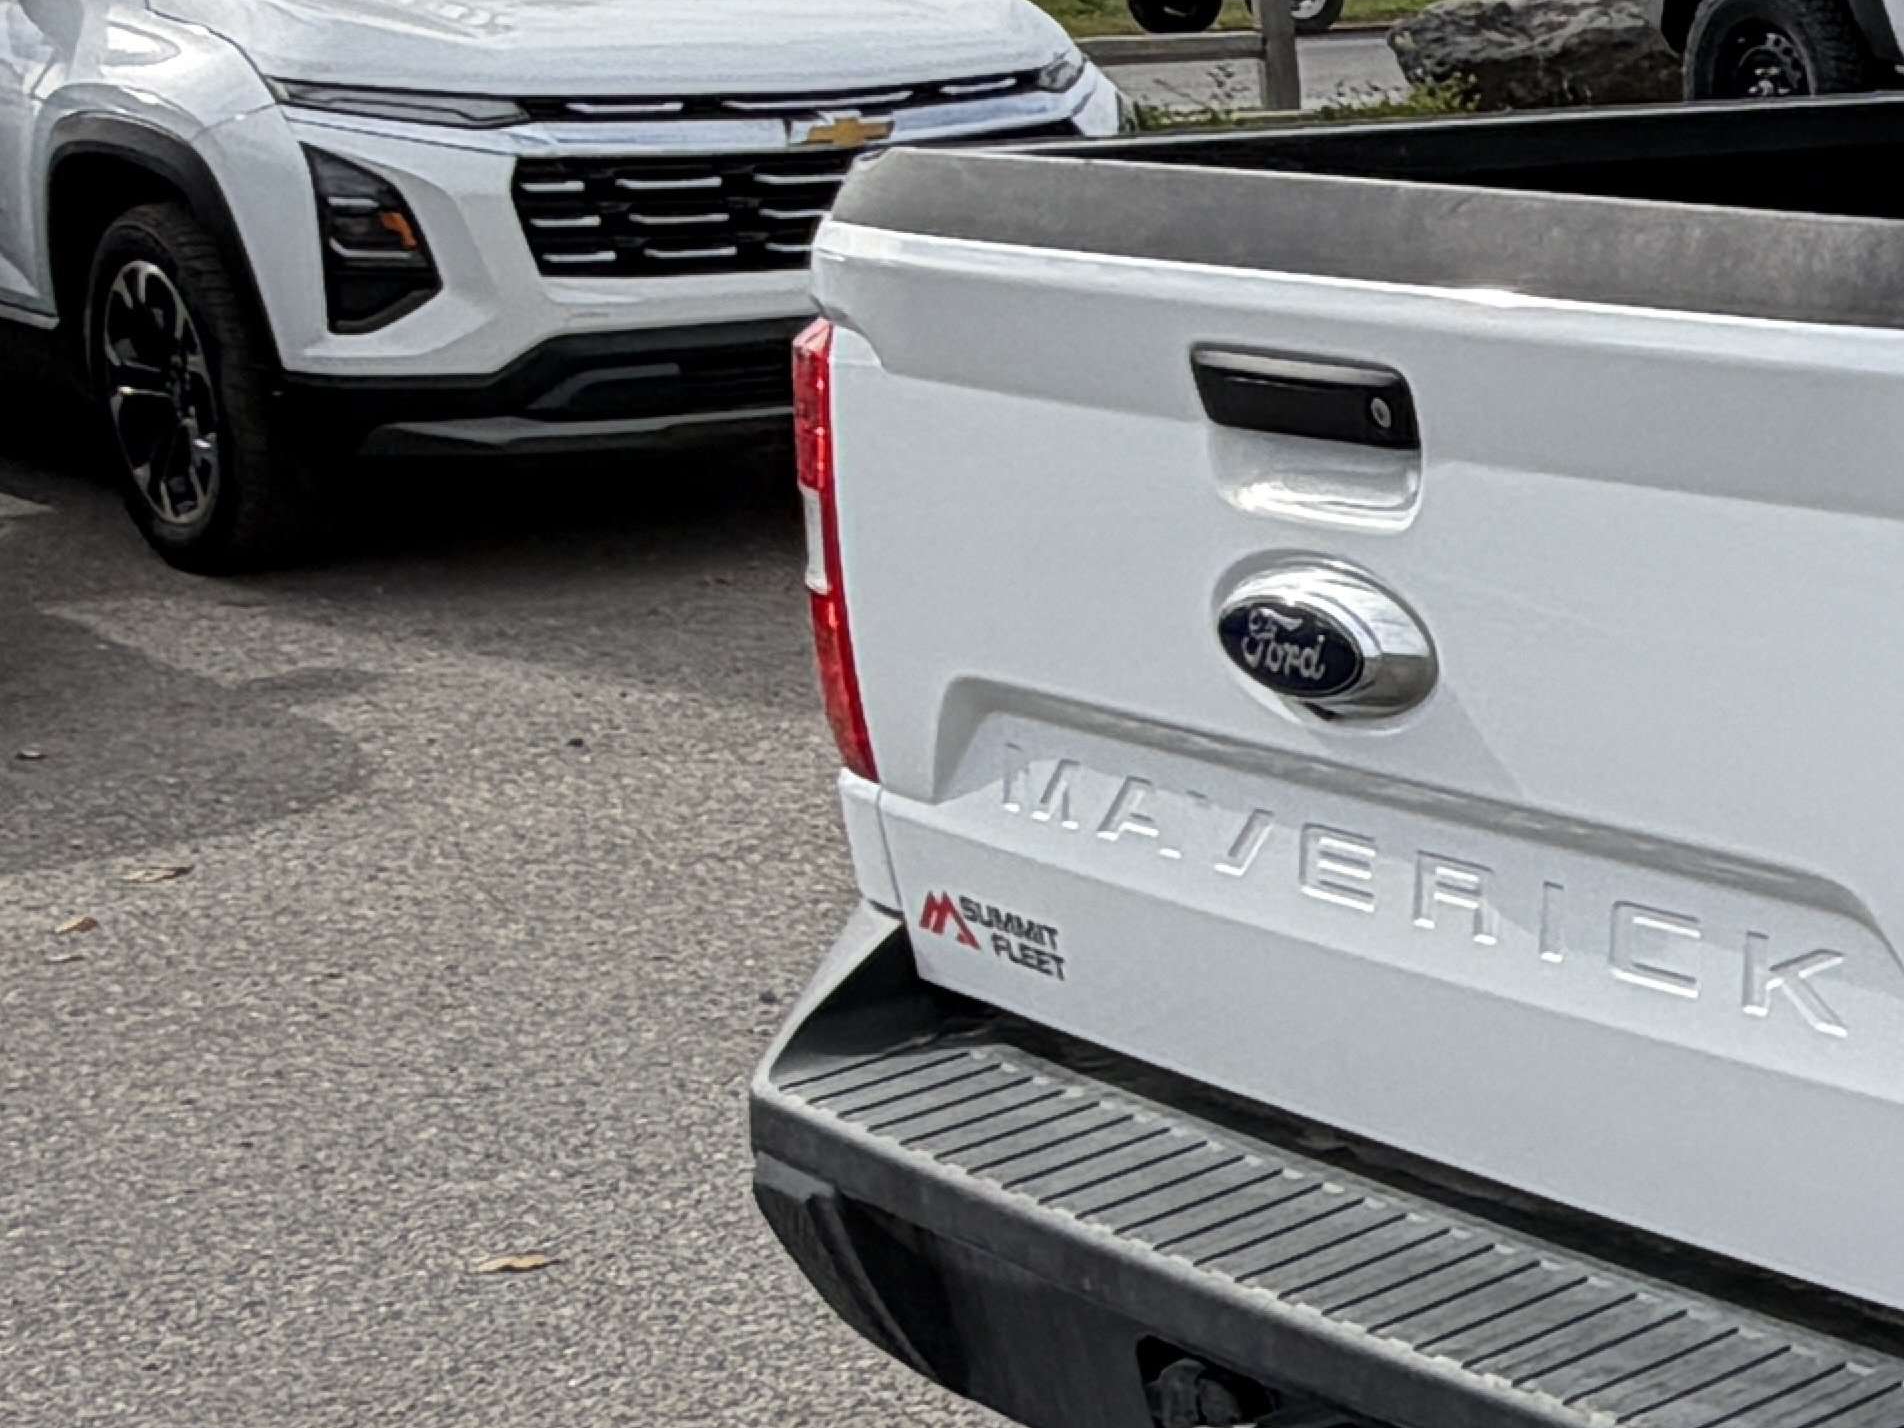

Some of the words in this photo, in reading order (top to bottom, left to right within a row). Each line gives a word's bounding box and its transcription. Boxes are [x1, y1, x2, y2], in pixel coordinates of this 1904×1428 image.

[1241, 607, 1327, 680] Ford
[1001, 740, 1848, 1038] MAVERICK
[959, 895, 1058, 950] SUMMIT
[991, 932, 1065, 981] FLEET
